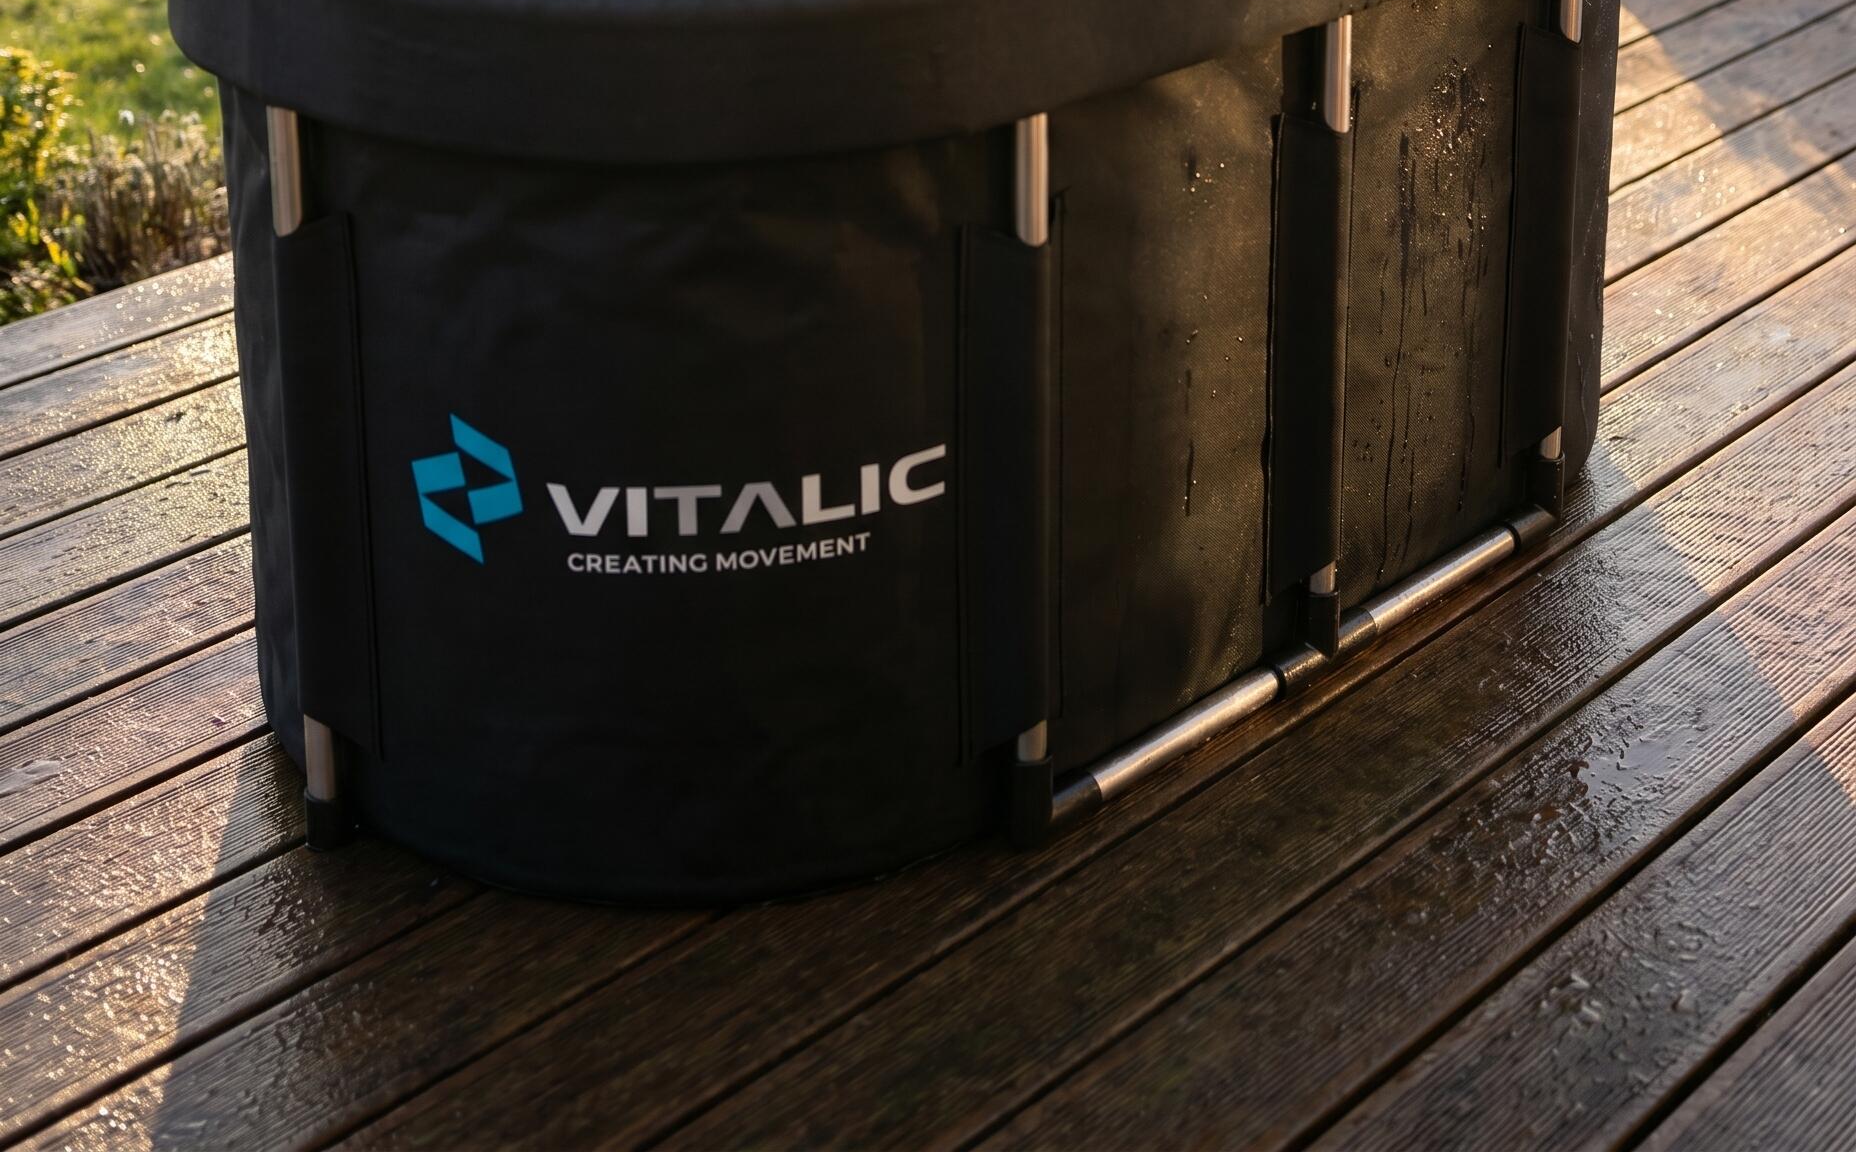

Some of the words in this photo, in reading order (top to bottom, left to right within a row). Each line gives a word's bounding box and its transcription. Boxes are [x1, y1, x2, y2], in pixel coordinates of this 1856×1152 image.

[546, 444, 946, 537] VITALIC
[567, 553, 707, 573] CREATING
[716, 532, 871, 571] MOVEMENT
